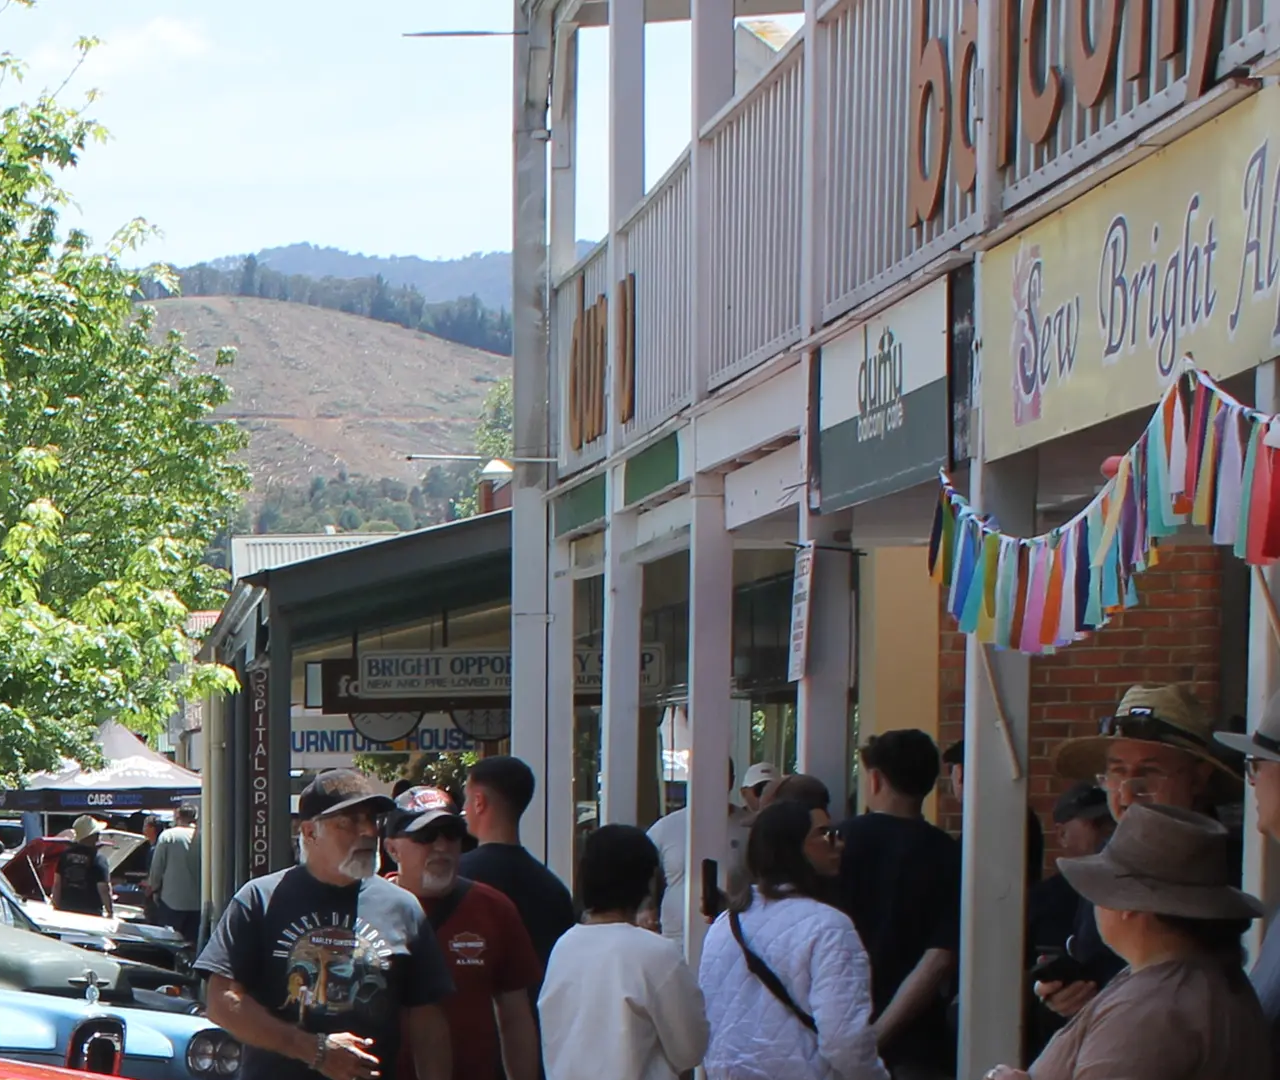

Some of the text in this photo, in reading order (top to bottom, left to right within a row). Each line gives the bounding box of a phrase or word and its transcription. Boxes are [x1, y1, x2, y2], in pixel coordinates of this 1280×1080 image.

[1018, 138, 1280, 397] Sew Bright Al
[367, 657, 442, 677] BRIGHT
[367, 680, 392, 689] NEW
[396, 679, 420, 688] AND
[253, 669, 268, 771] OSPITAL
[87, 793, 113, 805] CARS
[253, 809, 268, 867] SHOP
